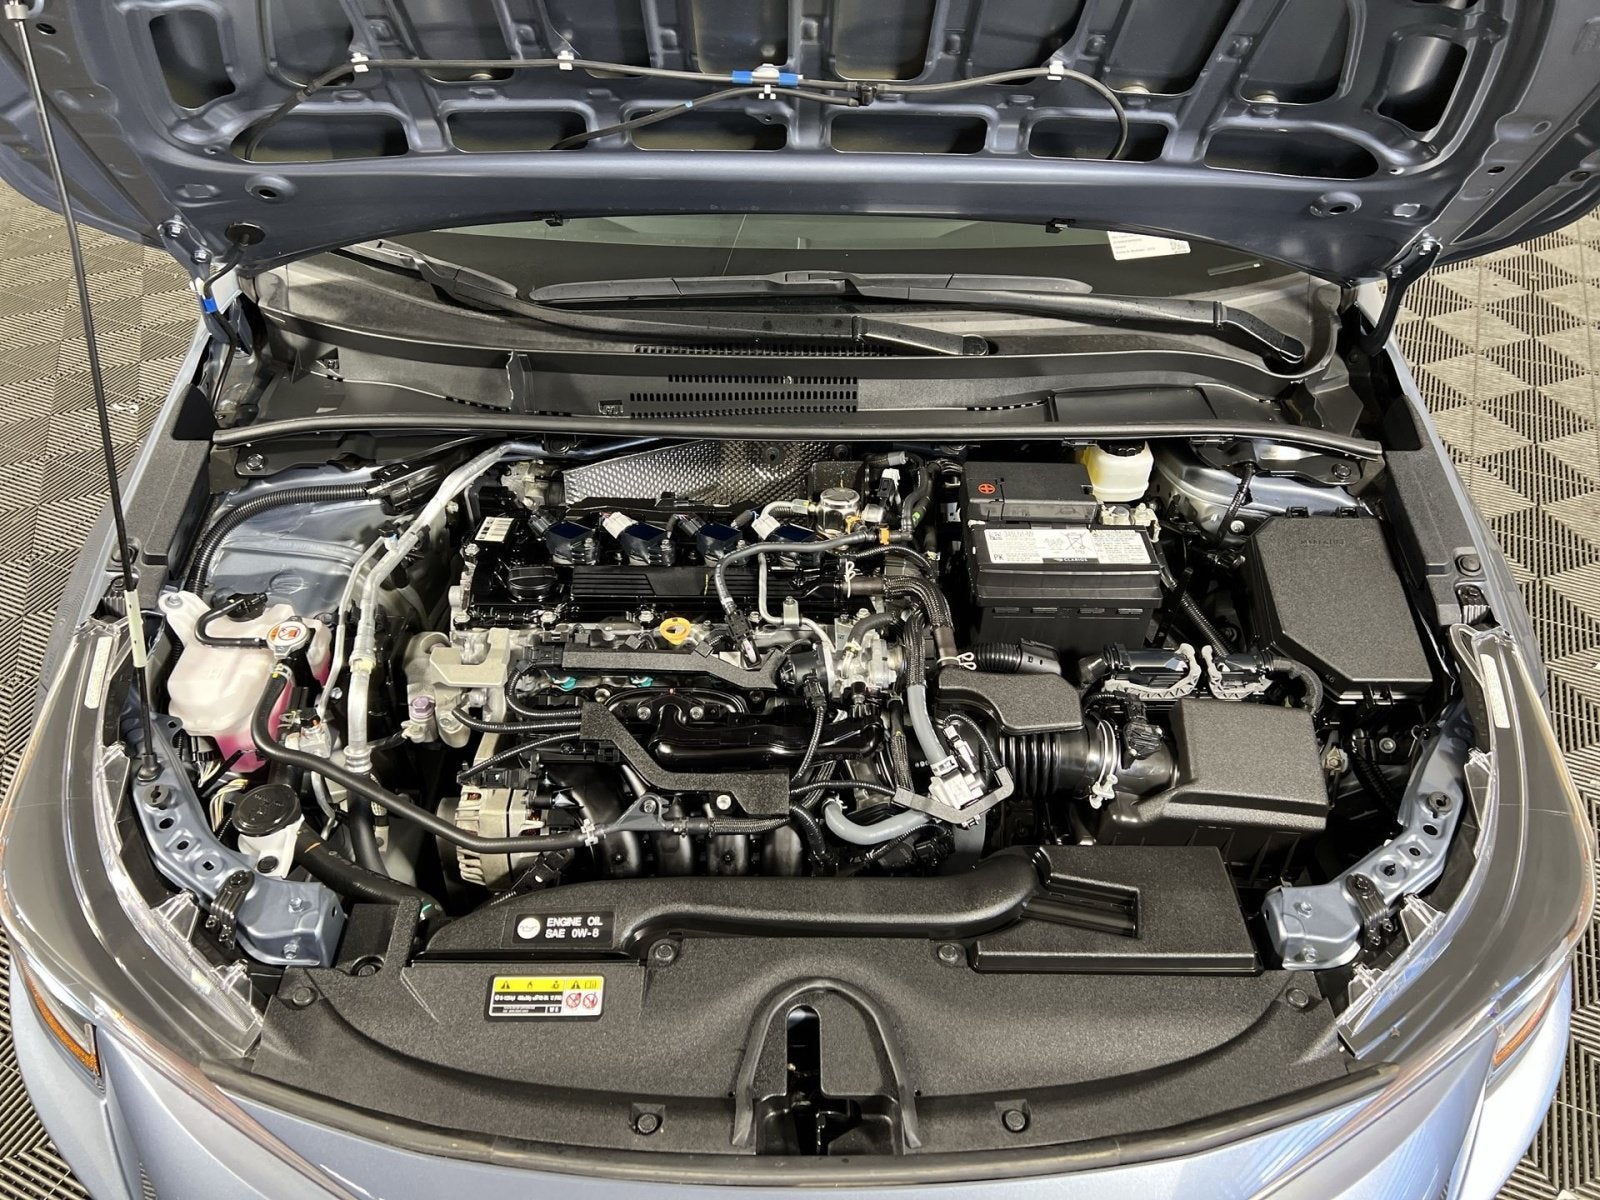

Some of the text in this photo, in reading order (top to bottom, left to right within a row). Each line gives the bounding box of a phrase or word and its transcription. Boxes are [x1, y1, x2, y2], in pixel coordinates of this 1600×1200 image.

[546, 916, 603, 927] ENGINE OIL
[545, 928, 599, 939] SAE 0W-8
